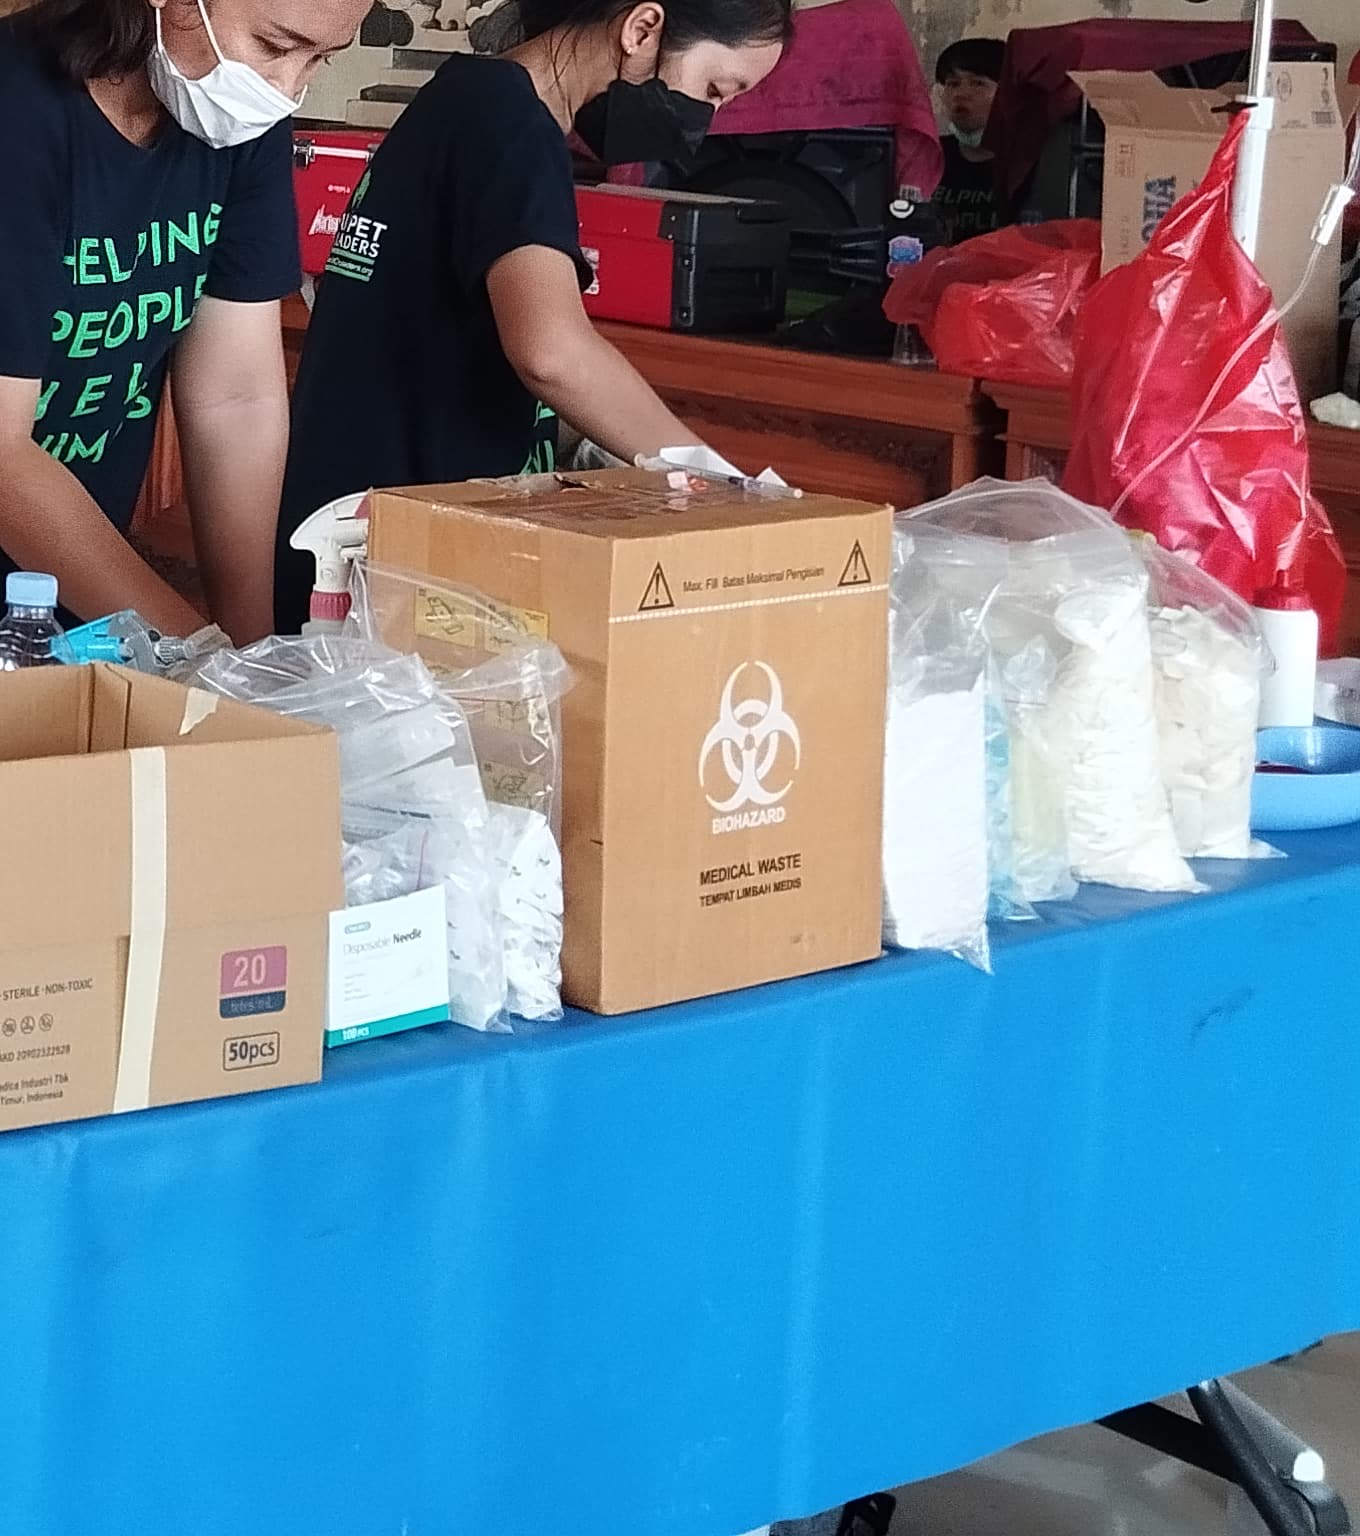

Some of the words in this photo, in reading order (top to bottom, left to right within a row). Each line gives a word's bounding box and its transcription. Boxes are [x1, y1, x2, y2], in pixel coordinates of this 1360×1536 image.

[711, 805, 786, 835] BIOHAZARD
[699, 861, 756, 886] MEDICAL
[757, 853, 802, 876] WASTE
[699, 889, 736, 907] TEMPAT
[736, 882, 772, 900] LIMBAH
[773, 877, 802, 892] MEDIS
[392, 928, 422, 945] Needle
[233, 953, 267, 988] 20
[2, 985, 40, 1001] STERILE
[44, 978, 93, 995] NON-TOXIC
[228, 1040, 276, 1064] 50pcs
[20, 1075, 53, 1089] Industri
